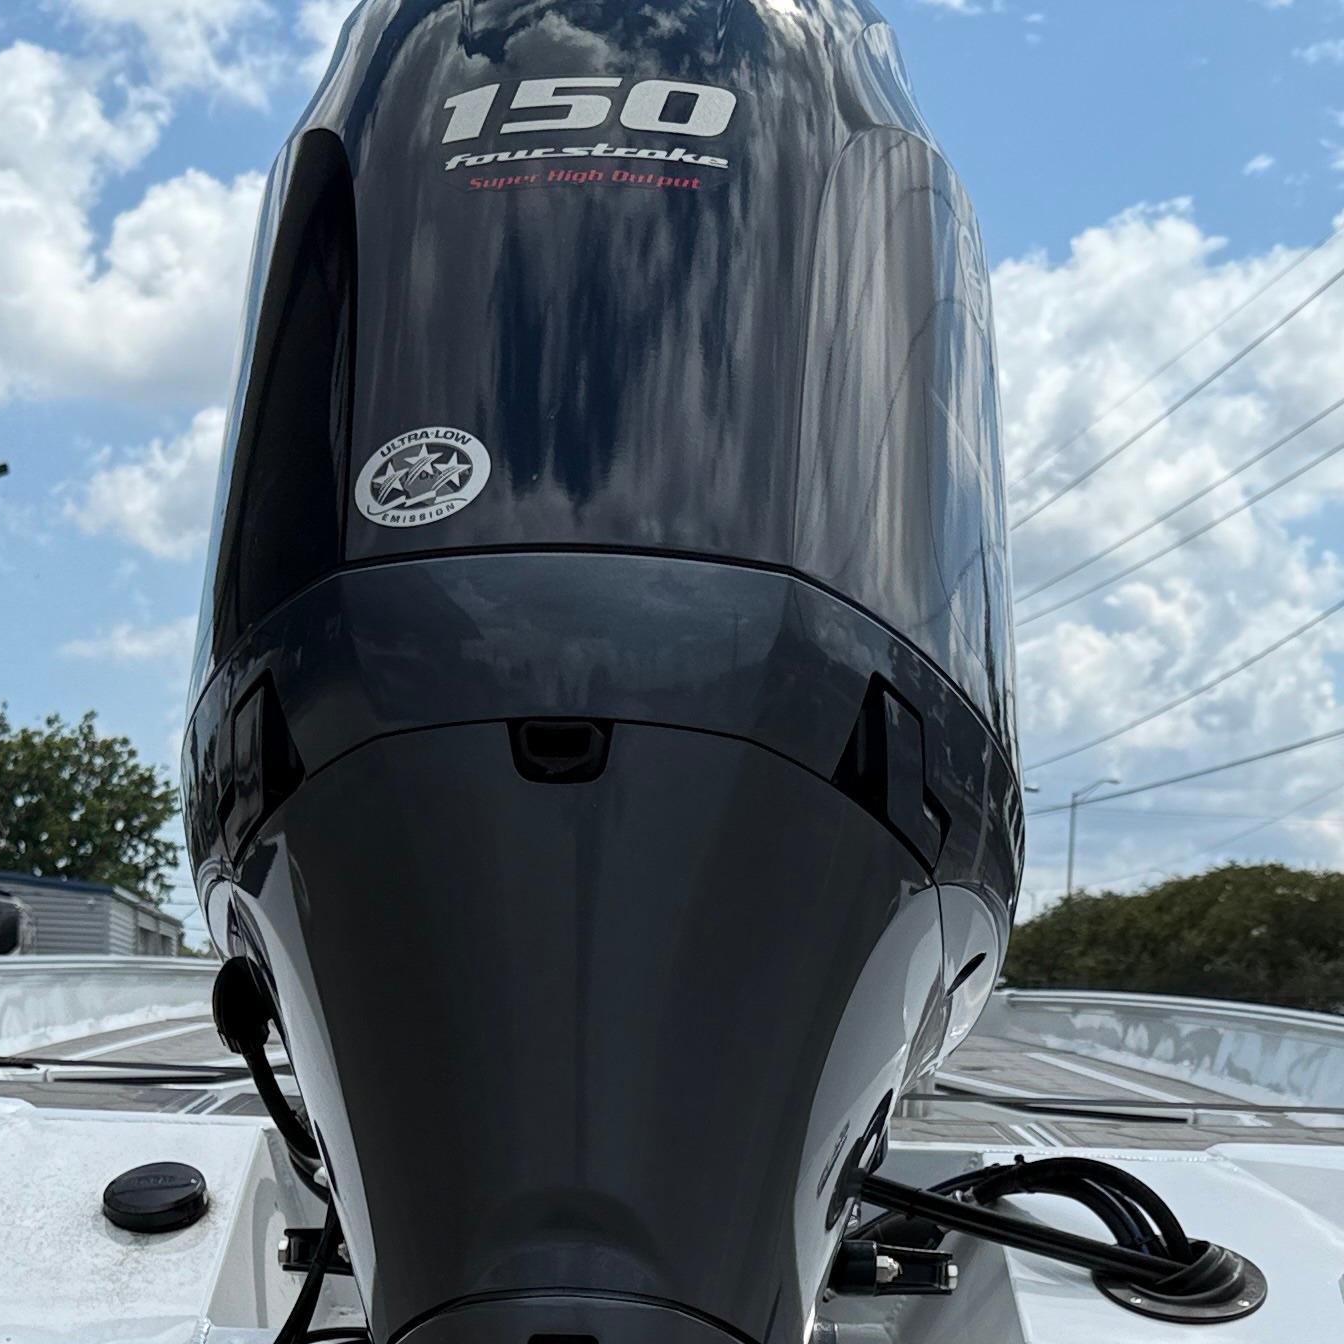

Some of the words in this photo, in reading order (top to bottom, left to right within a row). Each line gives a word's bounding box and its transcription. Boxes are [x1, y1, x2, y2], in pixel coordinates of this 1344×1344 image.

[442, 77, 737, 144] 150
[469, 173, 539, 190] Super
[547, 169, 604, 184] High
[611, 169, 702, 190] Output
[381, 502, 456, 524] EMISSION
